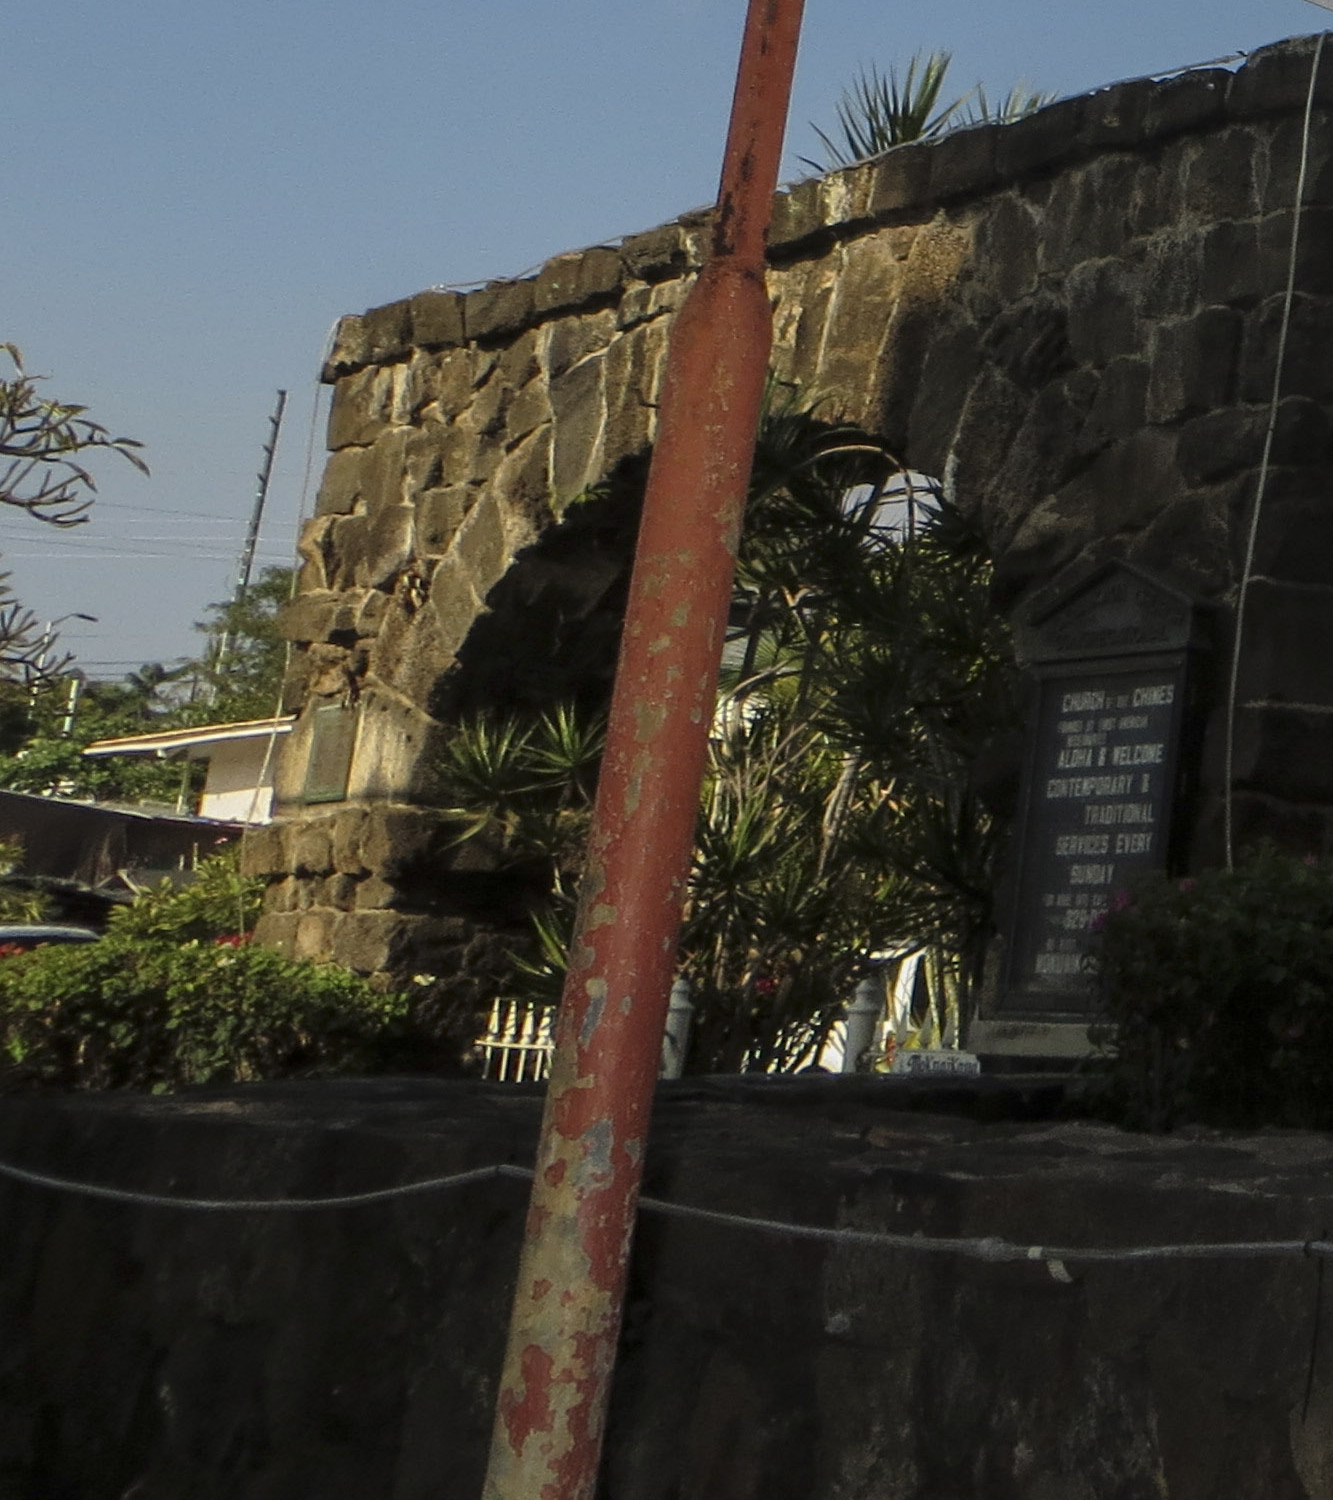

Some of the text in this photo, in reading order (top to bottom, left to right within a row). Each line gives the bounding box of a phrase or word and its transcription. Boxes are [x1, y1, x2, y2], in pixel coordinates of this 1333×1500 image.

[1062, 691, 1105, 713] CHURCH
[1057, 748, 1093, 769] ALOHA
[1112, 744, 1164, 767] WELCOME
[1046, 775, 1134, 799] CONTEMPORARY
[1084, 803, 1154, 826] TRADITIONAL
[1115, 832, 1153, 854] EVERY
[1069, 863, 1115, 886] SUNDAY
